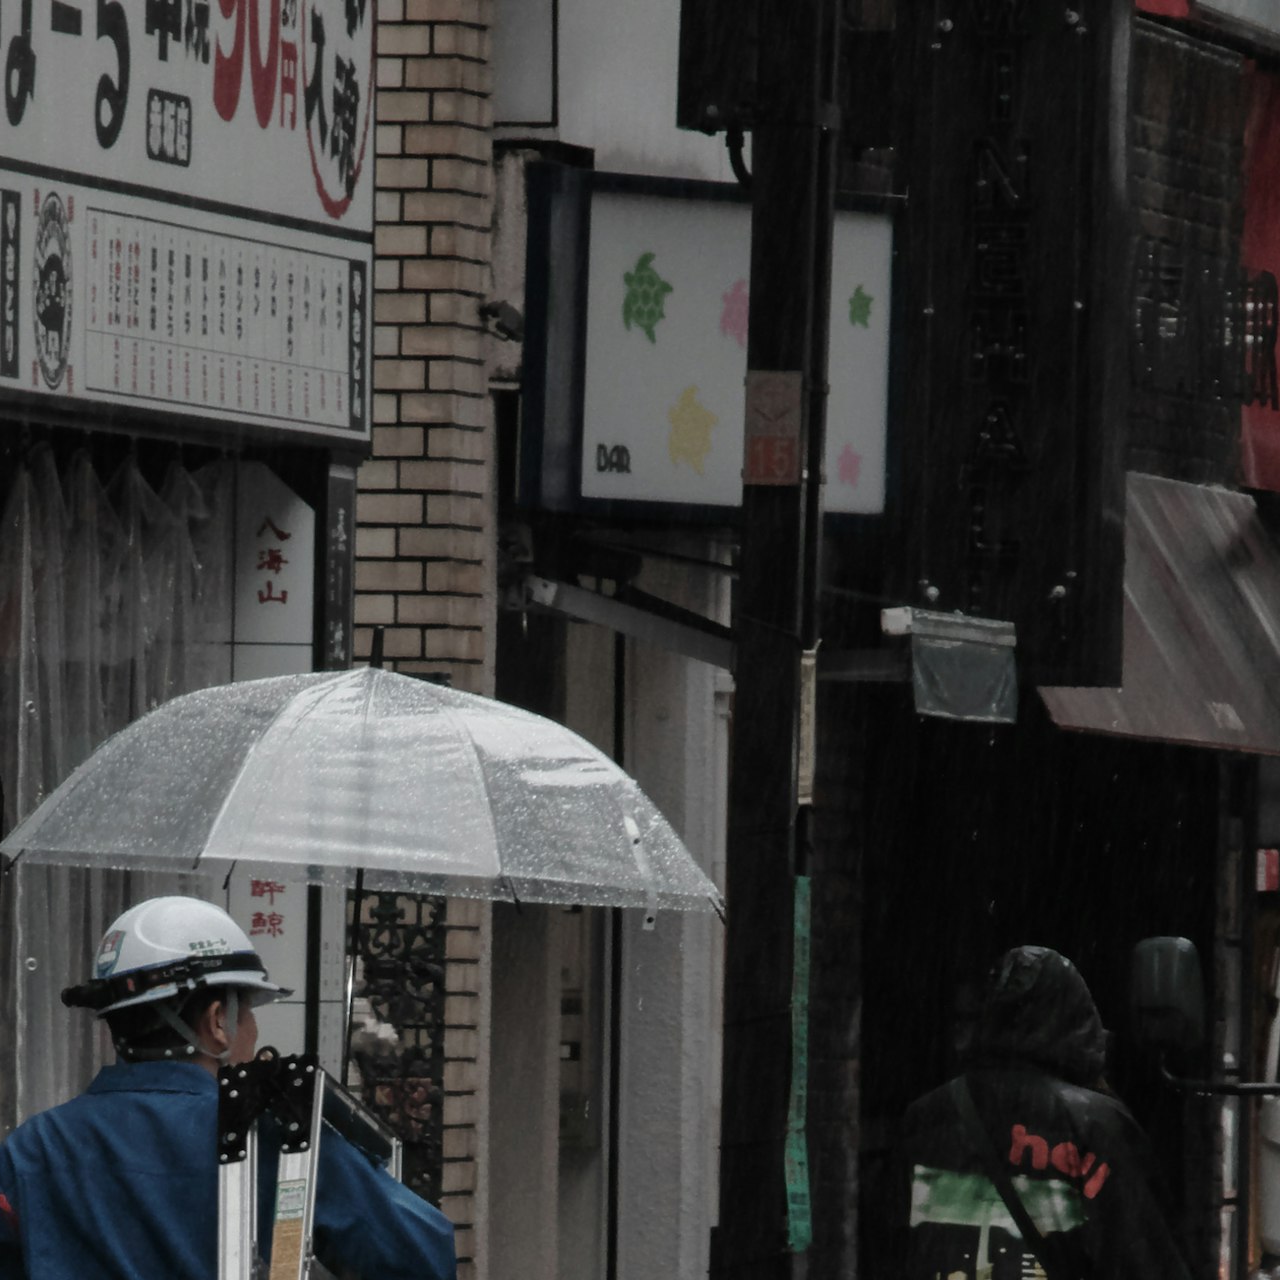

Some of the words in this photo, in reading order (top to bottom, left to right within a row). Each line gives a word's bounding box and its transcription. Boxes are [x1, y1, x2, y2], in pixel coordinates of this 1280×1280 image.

[753, 440, 790, 475] 15
[256, 516, 292, 606] 八海山
[249, 879, 286, 938] 酔鯨
